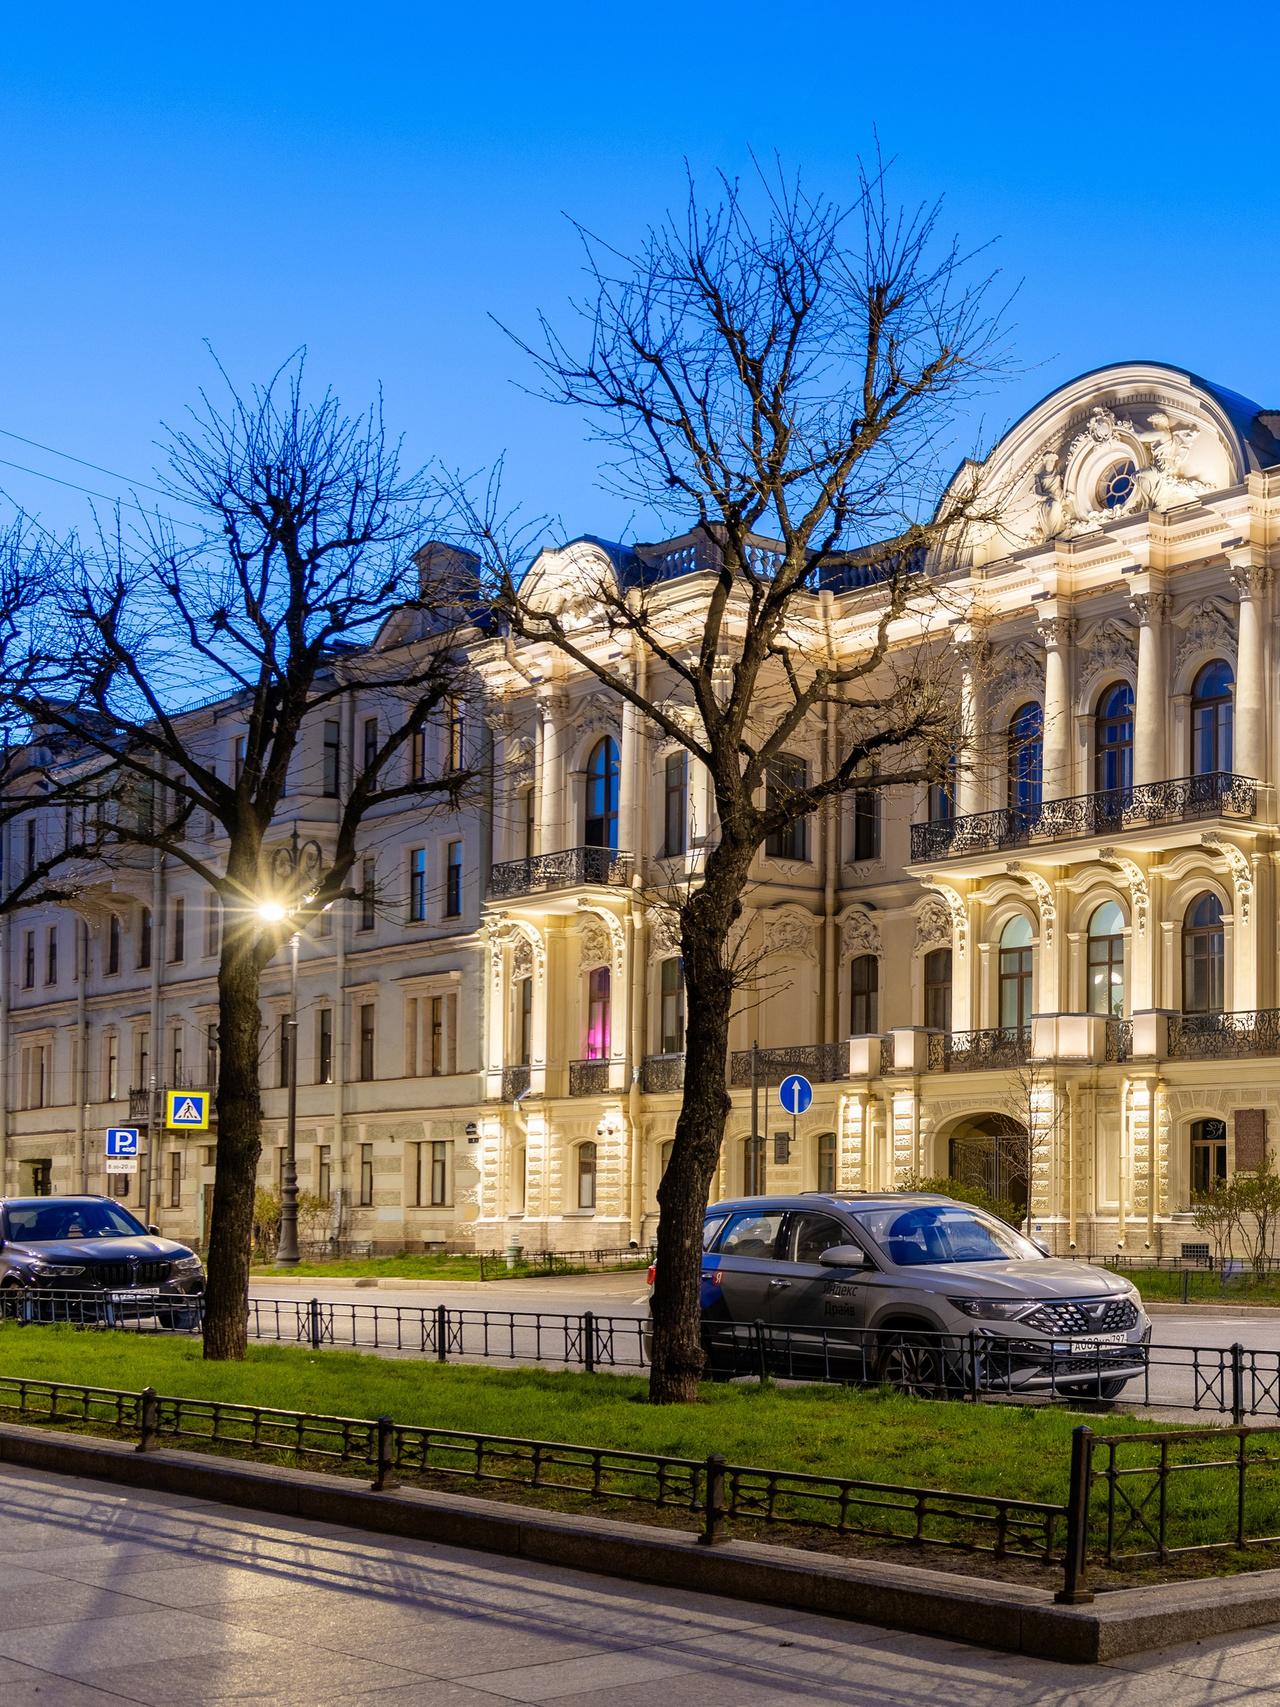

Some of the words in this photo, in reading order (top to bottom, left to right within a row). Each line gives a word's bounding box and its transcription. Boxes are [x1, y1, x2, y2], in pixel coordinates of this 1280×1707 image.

[115, 1131, 133, 1153] P
[715, 1271, 722, 1283] Я
[823, 1283, 859, 1297] Яндекс
[824, 1302, 855, 1317] Драйв
